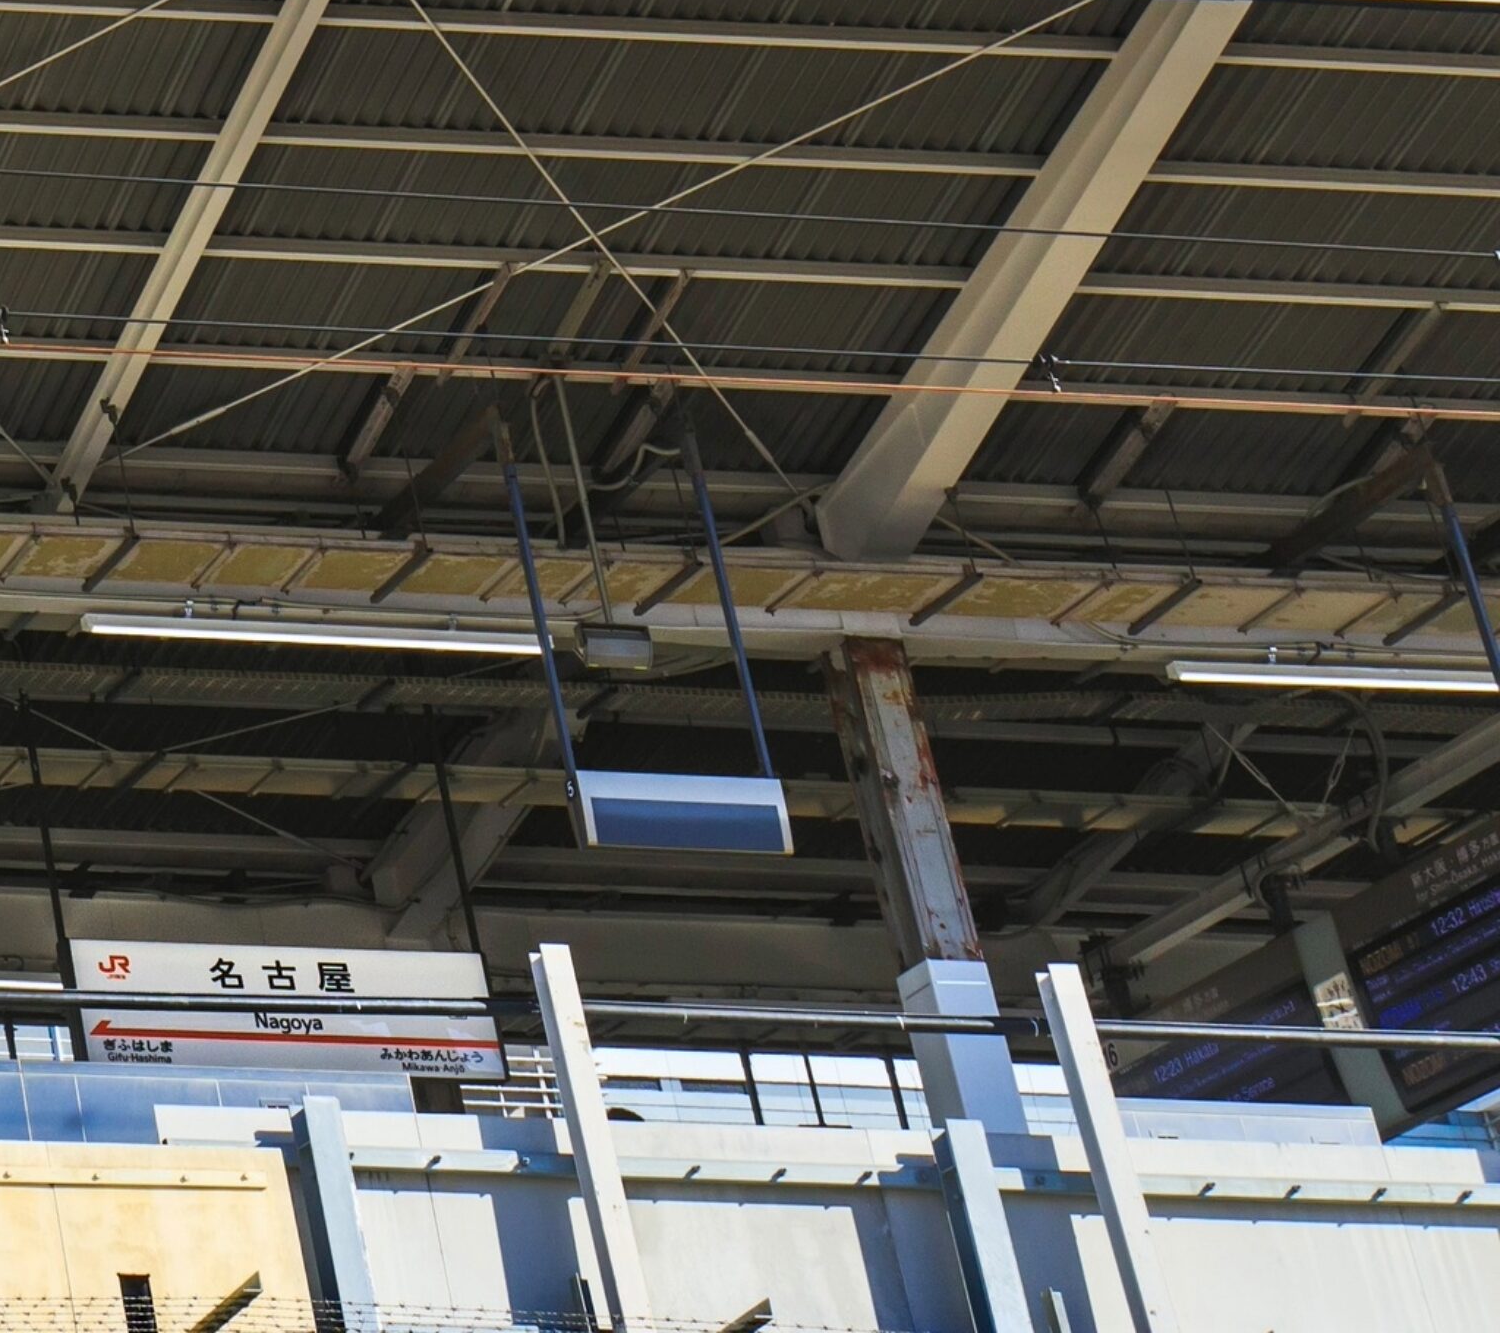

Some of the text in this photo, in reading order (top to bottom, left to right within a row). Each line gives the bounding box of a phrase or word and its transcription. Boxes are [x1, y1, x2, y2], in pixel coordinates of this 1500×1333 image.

[99, 955, 131, 974] JR
[209, 957, 355, 993] 名古屋
[255, 1012, 324, 1035] Nagoya
[103, 1039, 173, 1053] ぎふはしま
[380, 1048, 484, 1063] みかわあんじょう
